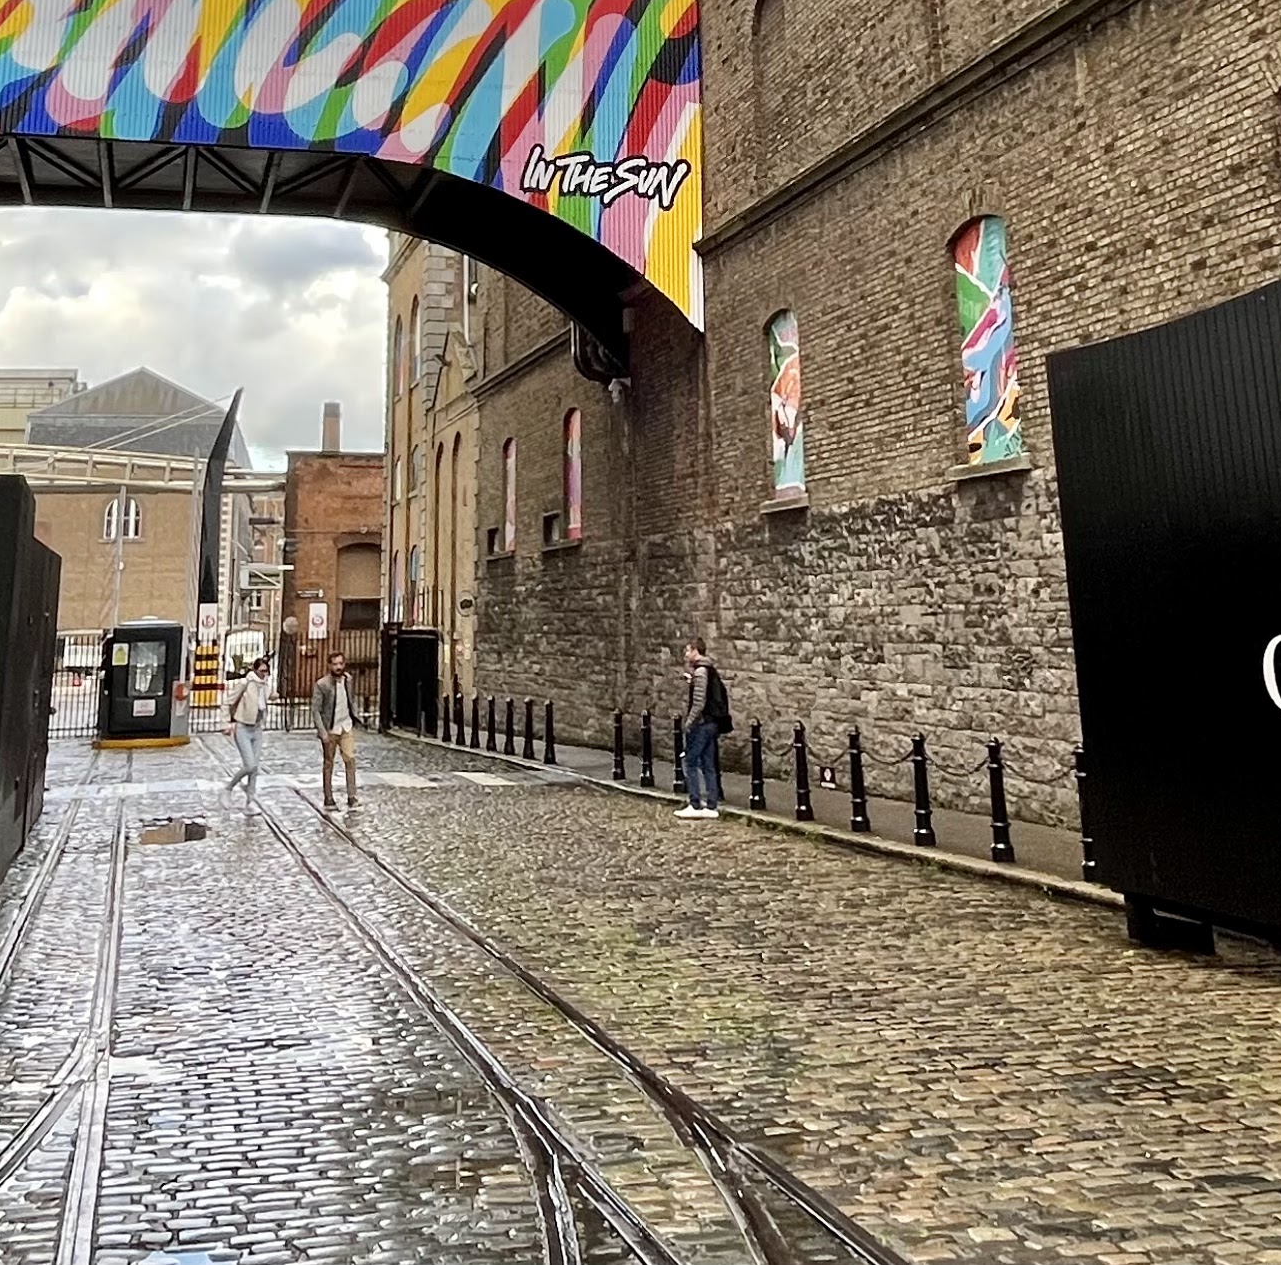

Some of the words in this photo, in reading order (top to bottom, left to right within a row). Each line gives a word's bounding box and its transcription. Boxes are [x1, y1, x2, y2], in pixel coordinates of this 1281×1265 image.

[523, 146, 555, 190] IN
[556, 155, 613, 193] THE
[603, 158, 688, 208] SUN
